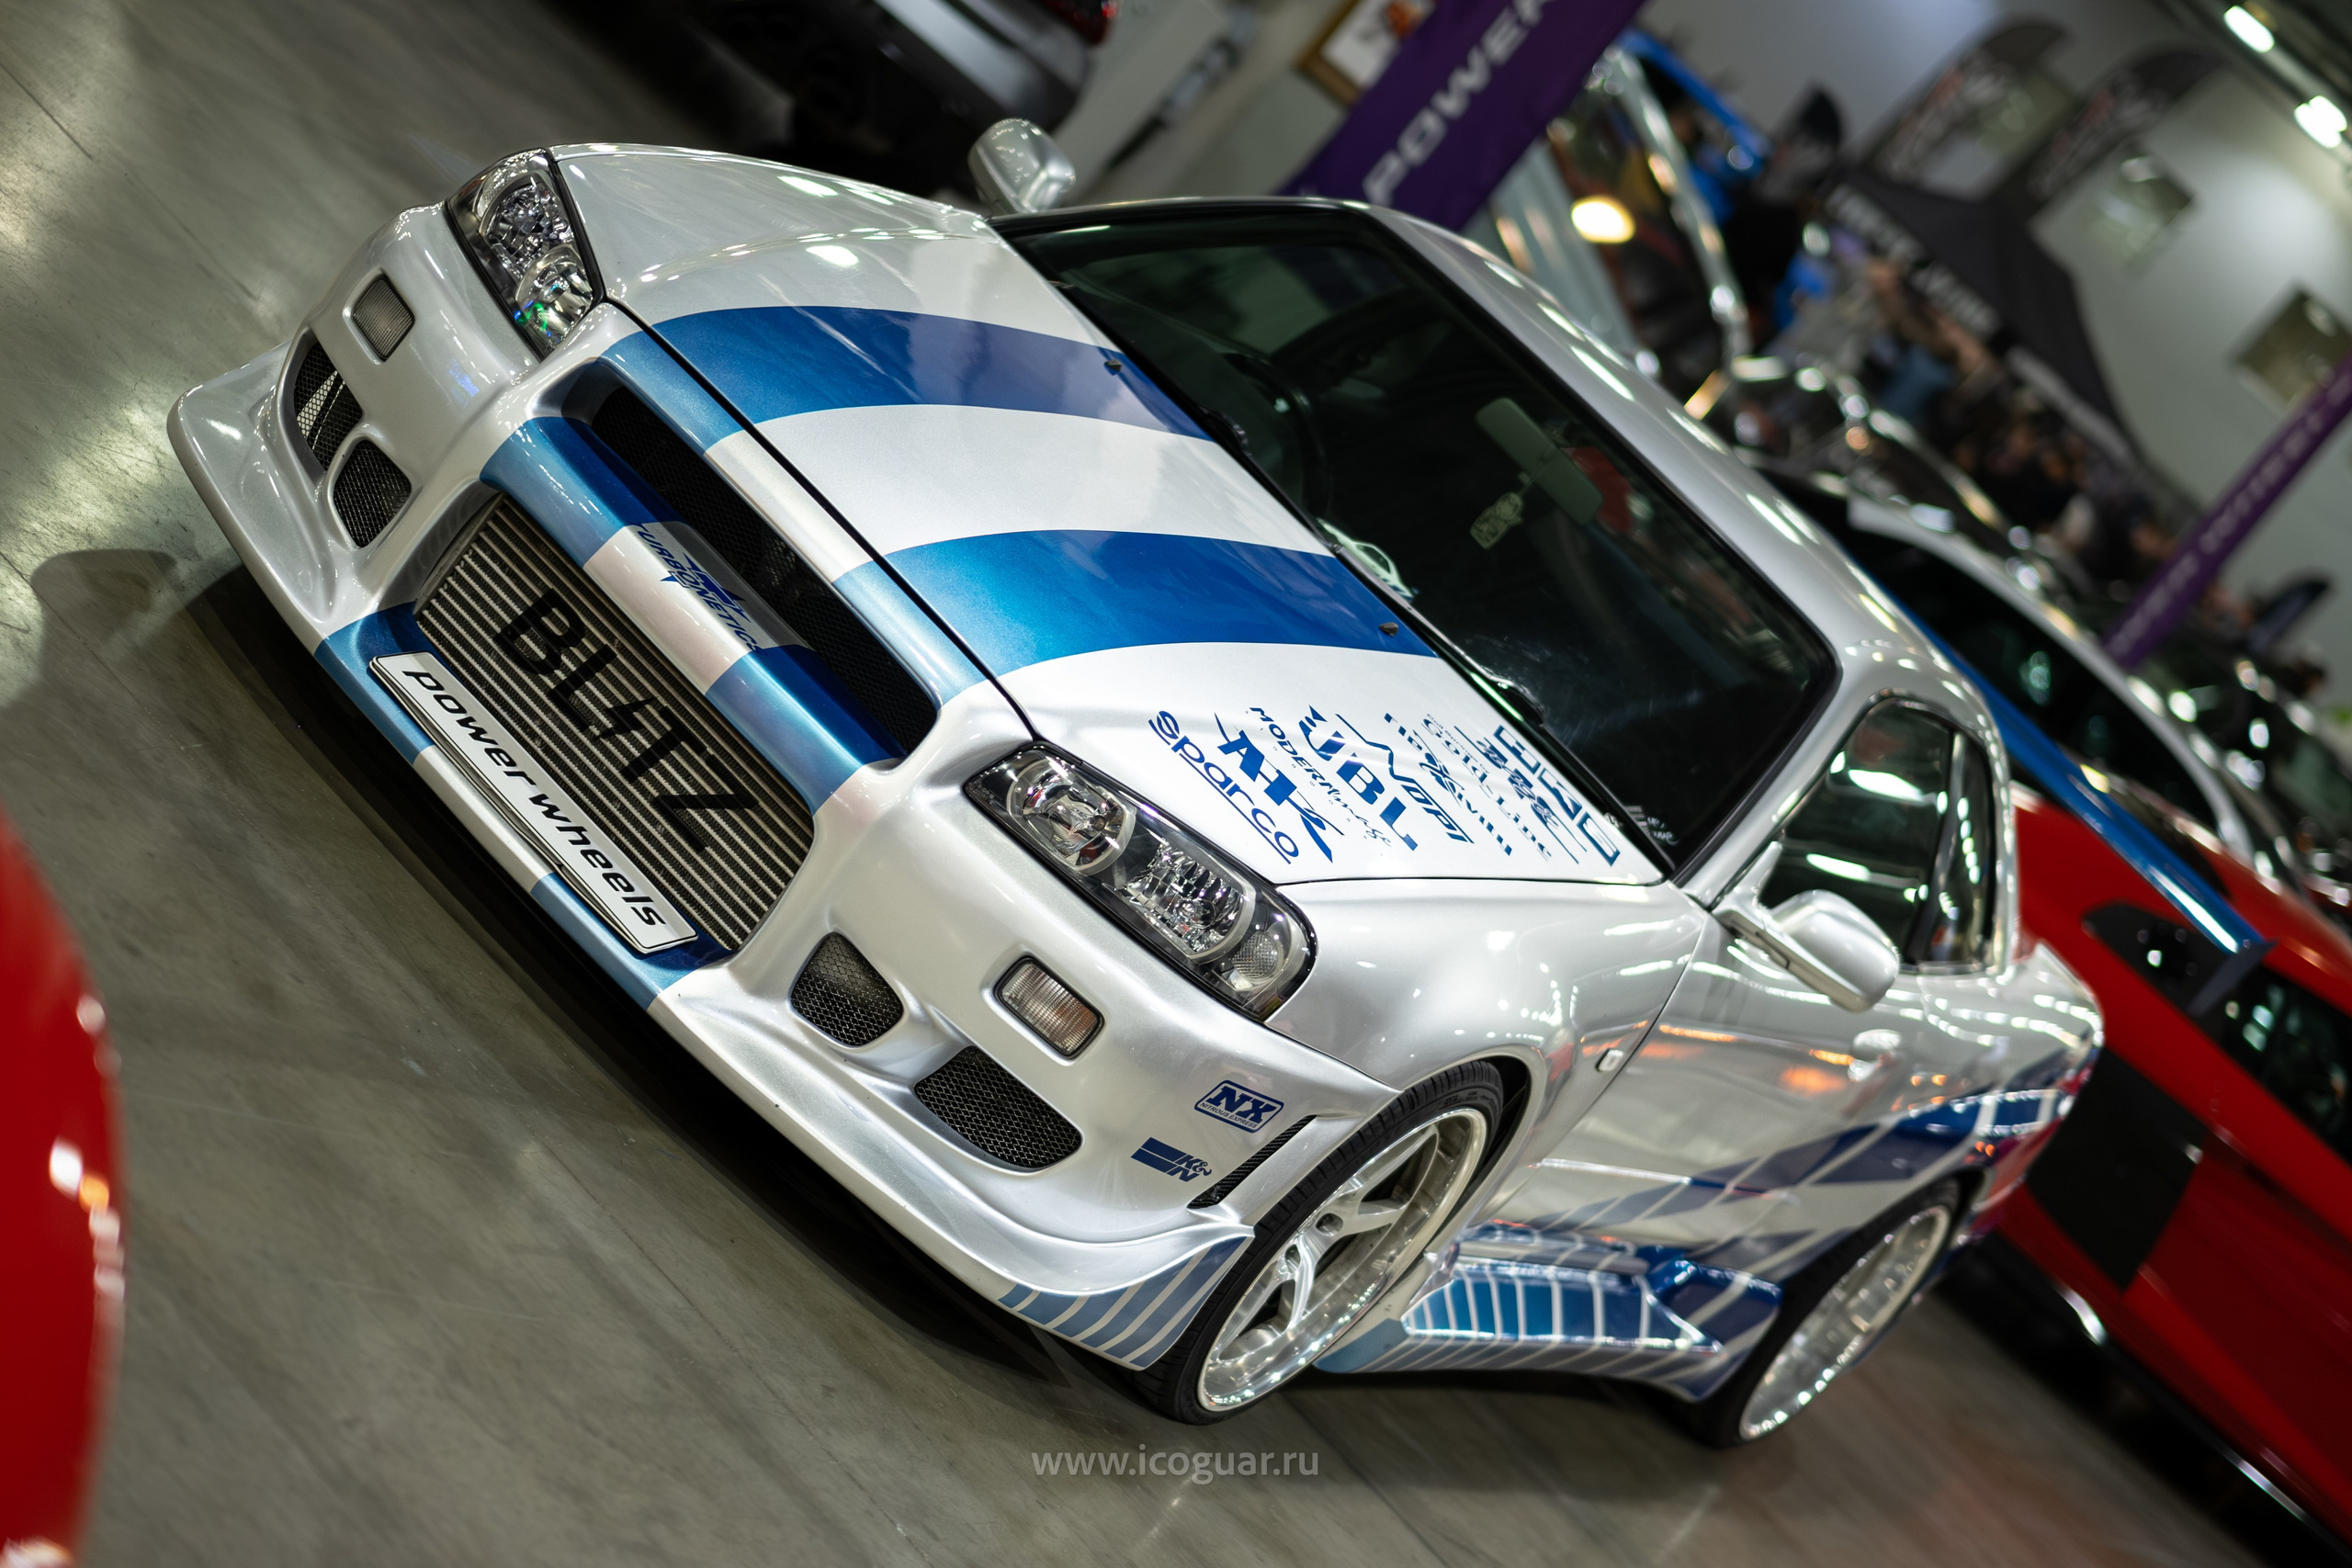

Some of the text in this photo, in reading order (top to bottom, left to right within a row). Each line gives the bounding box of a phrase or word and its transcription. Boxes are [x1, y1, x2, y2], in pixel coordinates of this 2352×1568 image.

[493, 588, 759, 852] BLITZ
[1149, 711, 1299, 863] sparco
[1298, 718, 1419, 852] JBL
[401, 670, 667, 927] power wheels
[1493, 725, 1621, 867] HKS
[1200, 1102, 1258, 1129] NITROUS EXPRESS
[1205, 1086, 1277, 1123] NX
